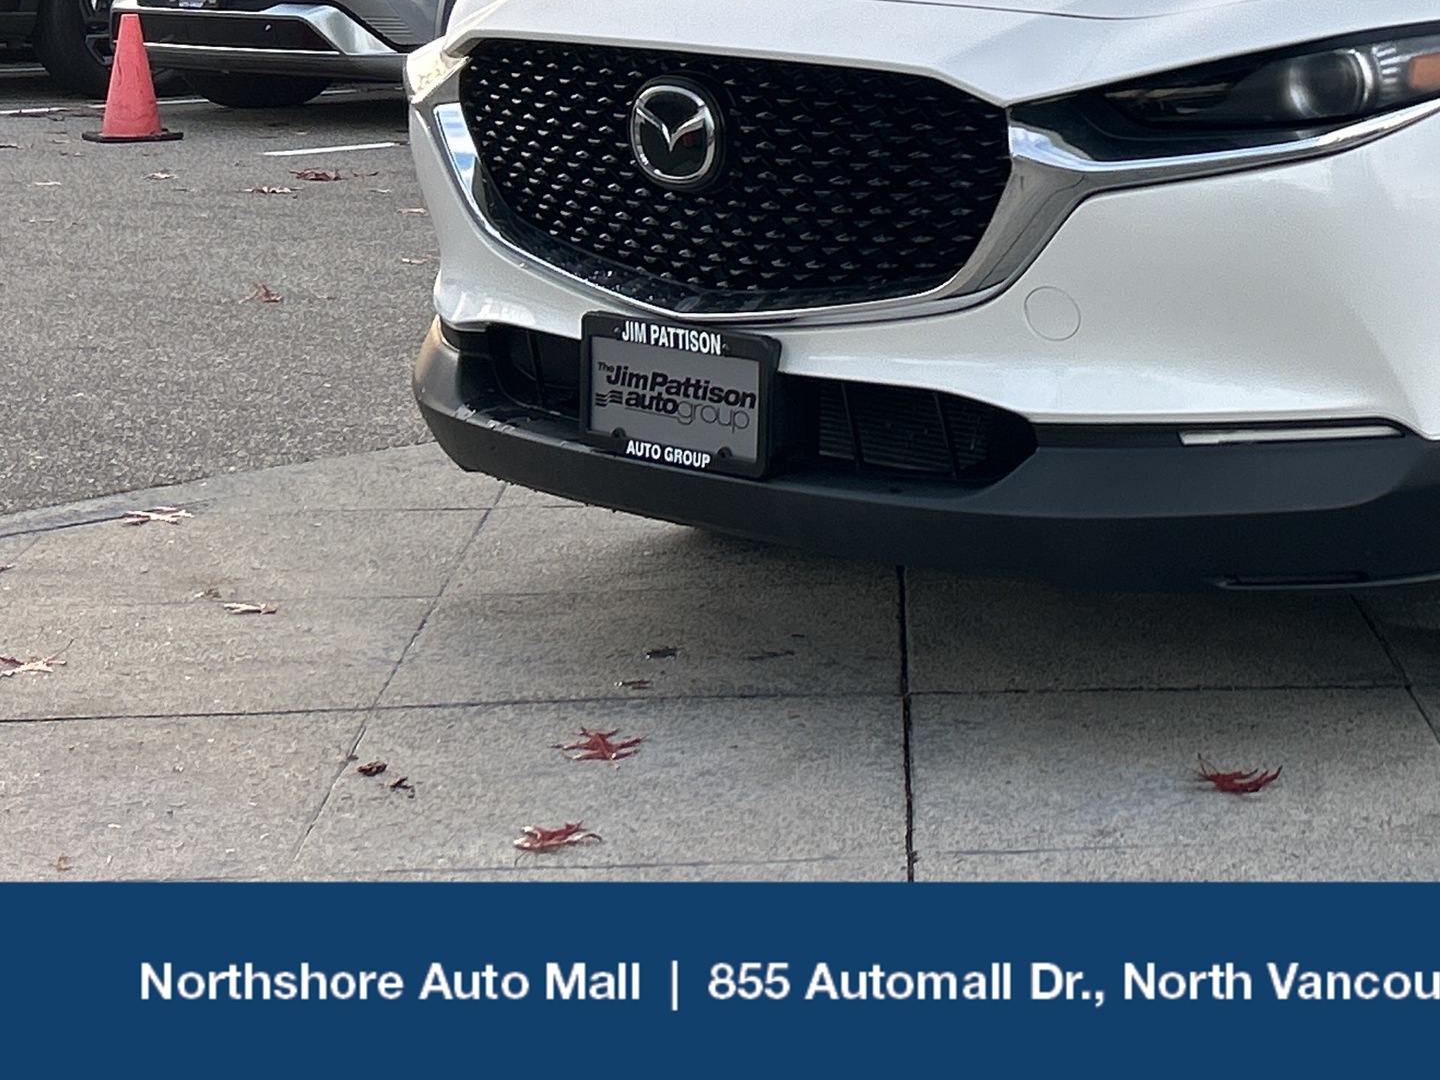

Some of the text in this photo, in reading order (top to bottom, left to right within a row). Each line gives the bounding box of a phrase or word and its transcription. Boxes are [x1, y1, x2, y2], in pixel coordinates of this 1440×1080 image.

[621, 320, 722, 356] JIM PATTISON
[625, 439, 712, 469] AUTO GROUP
